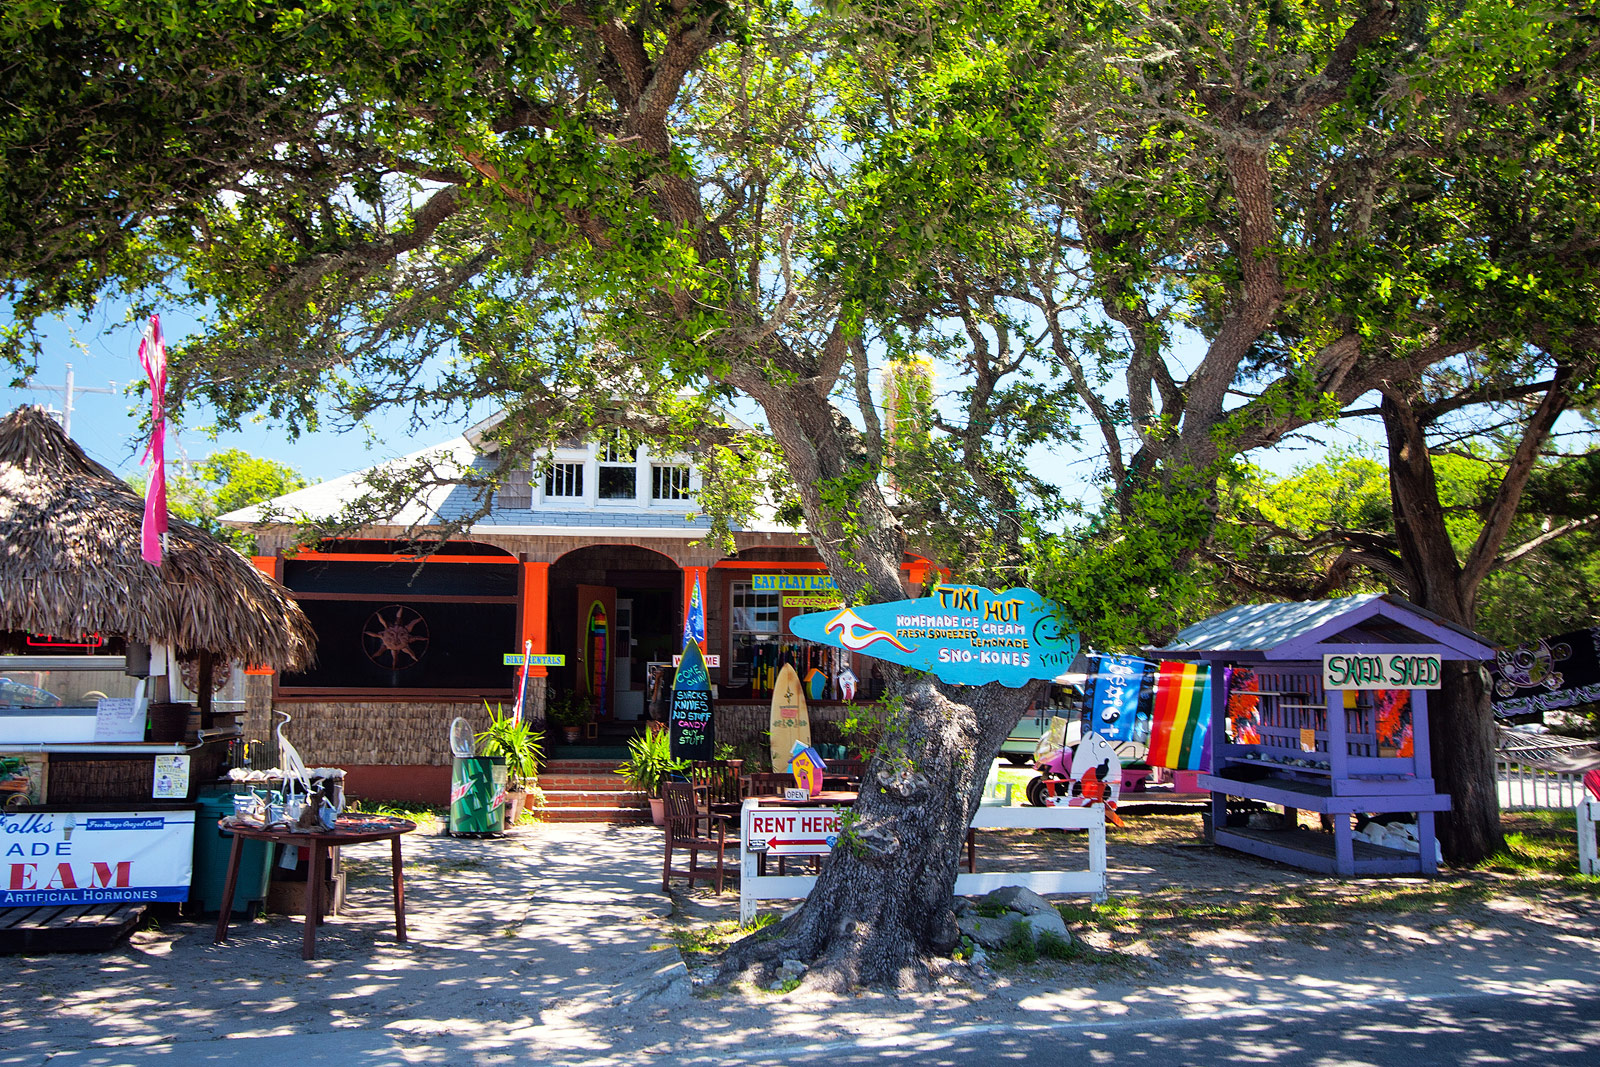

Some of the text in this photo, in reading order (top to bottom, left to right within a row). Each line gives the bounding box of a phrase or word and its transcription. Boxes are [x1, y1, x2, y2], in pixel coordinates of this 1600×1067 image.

[754, 576, 839, 590] EAT PLAY LAU
[936, 587, 1025, 622] TIKI HUT
[896, 614, 979, 629] HOMEMADE ICE
[896, 629, 978, 639] FRESH SQUEEZED
[981, 623, 1026, 635] CREAM
[970, 638, 1030, 649] LEMONADE
[505, 655, 524, 664] BIKE
[938, 647, 1031, 667] SNO-KONES
[676, 664, 699, 683] COME
[1328, 656, 1440, 686] SHELL SHED
[676, 690, 708, 700] SNACKS
[674, 700, 709, 711] KNIVES
[688, 712, 712, 722] STUFF
[678, 720, 707, 732] CANDY
[682, 729, 698, 738] GUY
[679, 735, 705, 746] STUFF
[787, 791, 804, 799] OPEN
[88, 820, 103, 828] Free
[104, 820, 122, 830] Range
[145, 818, 163, 828] Cattle
[753, 817, 842, 833] RENT HERE
[4, 890, 158, 903] ARTIFICIAL HORMONES
